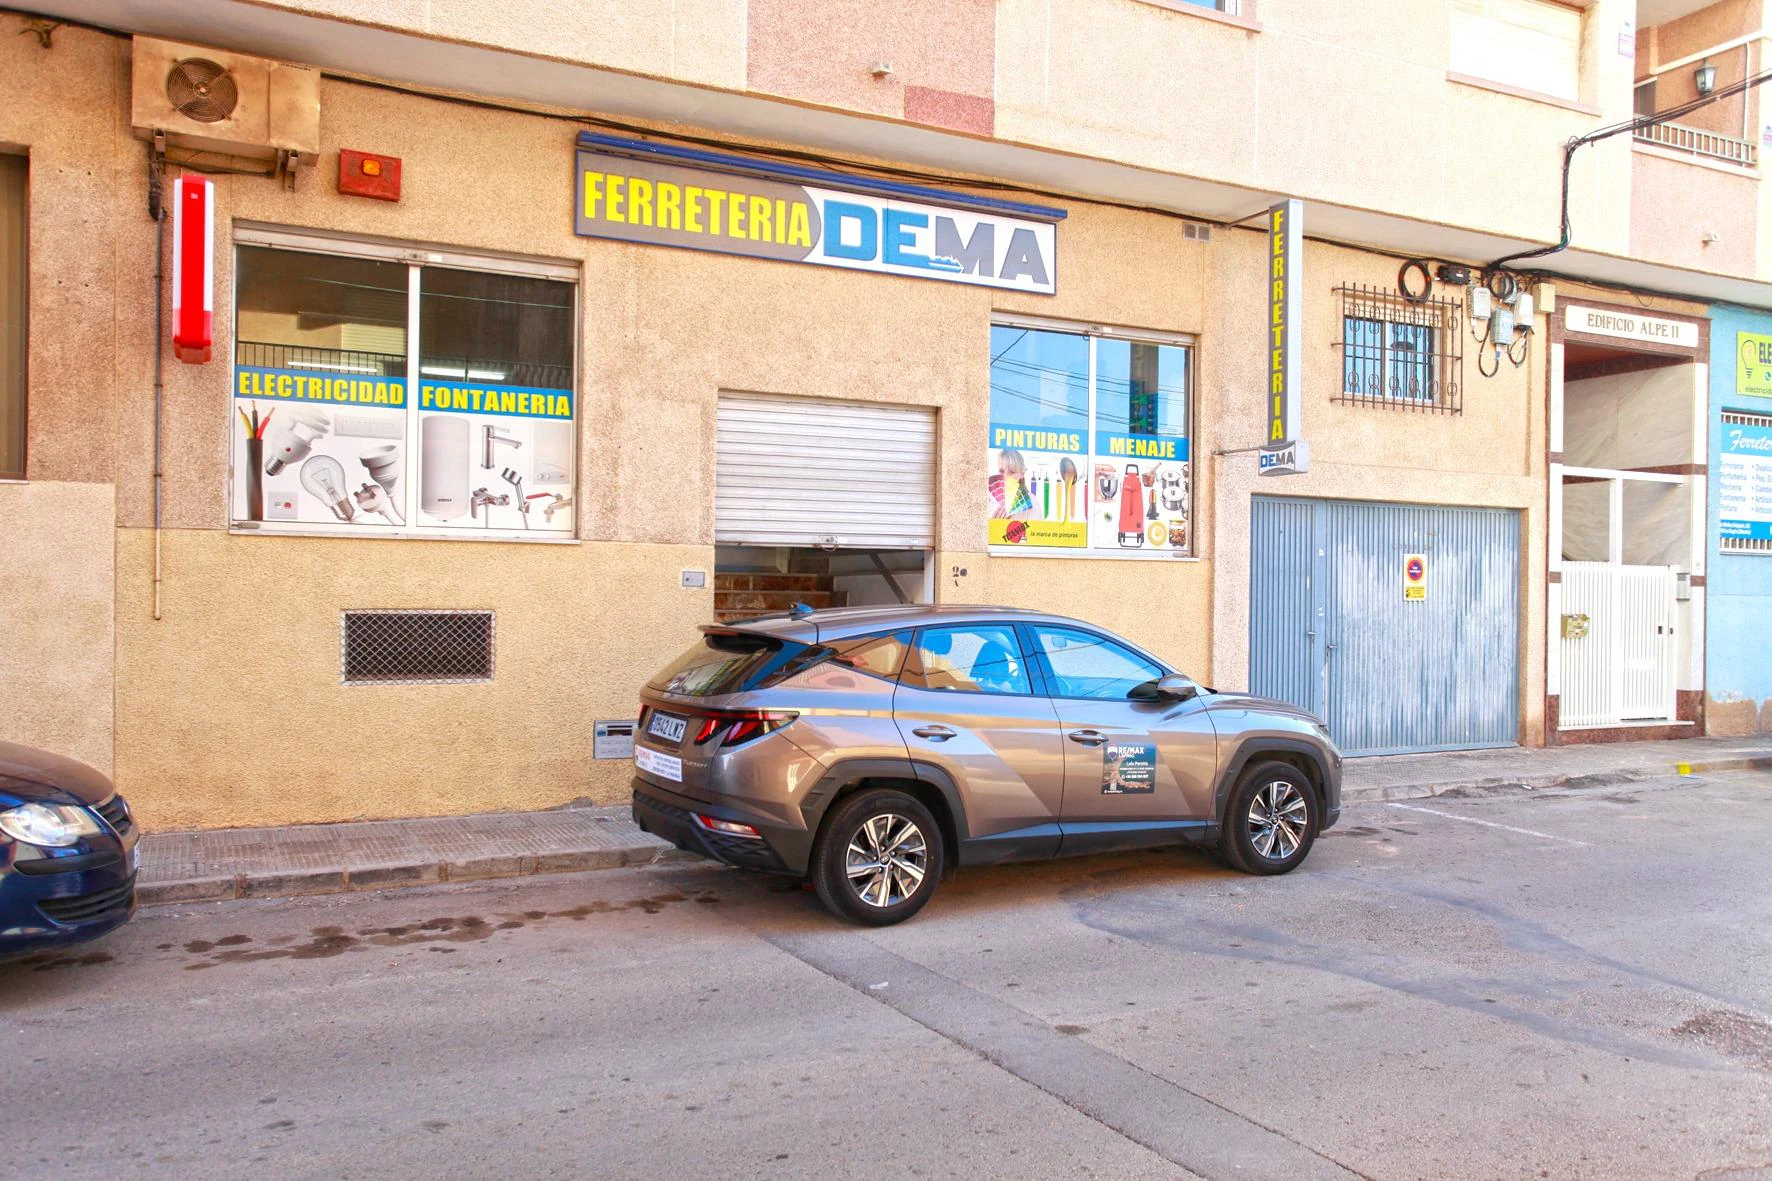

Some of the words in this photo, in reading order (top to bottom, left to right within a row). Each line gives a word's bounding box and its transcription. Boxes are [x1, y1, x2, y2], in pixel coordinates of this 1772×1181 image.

[584, 171, 811, 247] FERRETERIA
[823, 199, 1049, 285] DEMA
[1271, 210, 1284, 440] FERRETERIA
[1587, 313, 1634, 332] EDIFICIO
[1640, 321, 1669, 337] ALPE
[239, 372, 404, 405] ELECTRICIDAD
[422, 386, 570, 416] FONTANERIA
[995, 428, 1080, 452] PINTURAS
[1109, 437, 1176, 458] MENAJE
[1260, 451, 1294, 468] DEMA
[1002, 520, 1030, 543] TITANLUX
[1118, 746, 1144, 754] RE/MAX
